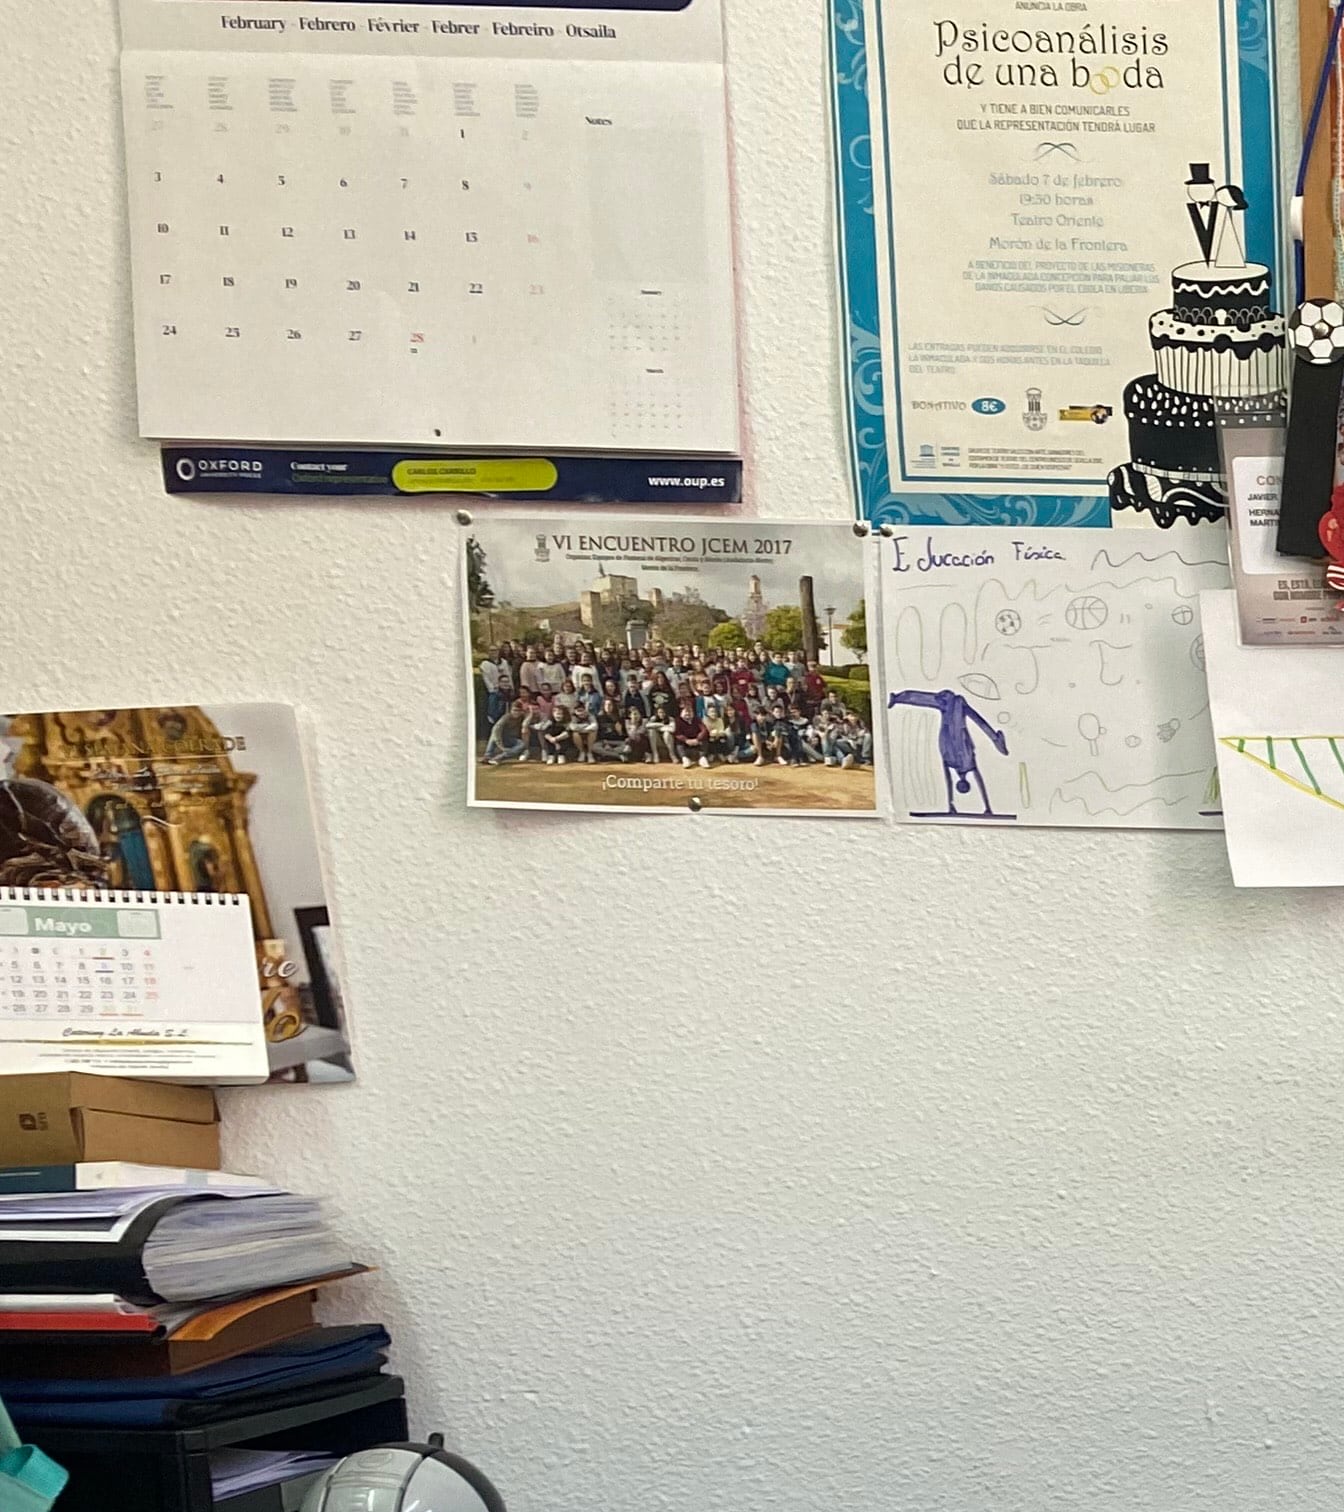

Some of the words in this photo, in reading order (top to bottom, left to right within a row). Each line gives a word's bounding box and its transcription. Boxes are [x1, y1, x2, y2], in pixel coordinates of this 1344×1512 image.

[1051, 3, 1062, 11] LA
[220, 15, 286, 34] February
[298, 17, 356, 34] Febrero
[367, 17, 419, 36] Février
[432, 20, 479, 36] Febrer
[492, 20, 554, 38] Febreiro
[566, 24, 616, 39] Otsaila
[934, 20, 1168, 57] Psicoanálisis
[943, 56, 985, 91] de
[995, 61, 1058, 87] una
[981, 105, 987, 114] Y
[990, 105, 1014, 115] TIENE
[1019, 106, 1026, 115] A
[1029, 105, 1051, 115] BIEN
[1055, 106, 1130, 117] COMUNICARLES
[956, 119, 976, 130] QUE
[979, 121, 991, 130] LA
[994, 118, 1077, 132] REPRESENTACIÓN
[1080, 119, 1121, 133] TENDRÁ
[1124, 122, 1156, 133] LUGAR
[989, 173, 1039, 186] Sábado
[1043, 175, 1050, 186] 7
[1053, 175, 1069, 188] de
[1073, 175, 1122, 189] febrero
[1056, 195, 1093, 206] horas
[1011, 214, 1052, 227] Teatro
[1056, 215, 1104, 227] Oriente
[989, 236, 1032, 250] Morón
[1036, 239, 1052, 251] de
[1056, 239, 1067, 250] la
[1071, 239, 1128, 252] Frontera
[162, 325, 177, 336] 24
[225, 327, 239, 338] 25
[287, 329, 302, 340] 26
[349, 330, 361, 341] 27
[410, 332, 424, 343] 28
[981, 400, 999, 412] 8€
[198, 459, 263, 472] OXFORD
[648, 475, 725, 488] www.oup.es
[553, 535, 573, 550] VI
[579, 535, 695, 553] ENCUENTRO
[702, 537, 748, 556] JCEM
[754, 540, 792, 555] 2017
[893, 536, 994, 572] Educación
[1012, 541, 1066, 561] Física
[602, 774, 684, 791] ¡Comparte
[708, 777, 759, 792] tesoro!
[35, 918, 92, 936] Mayo
